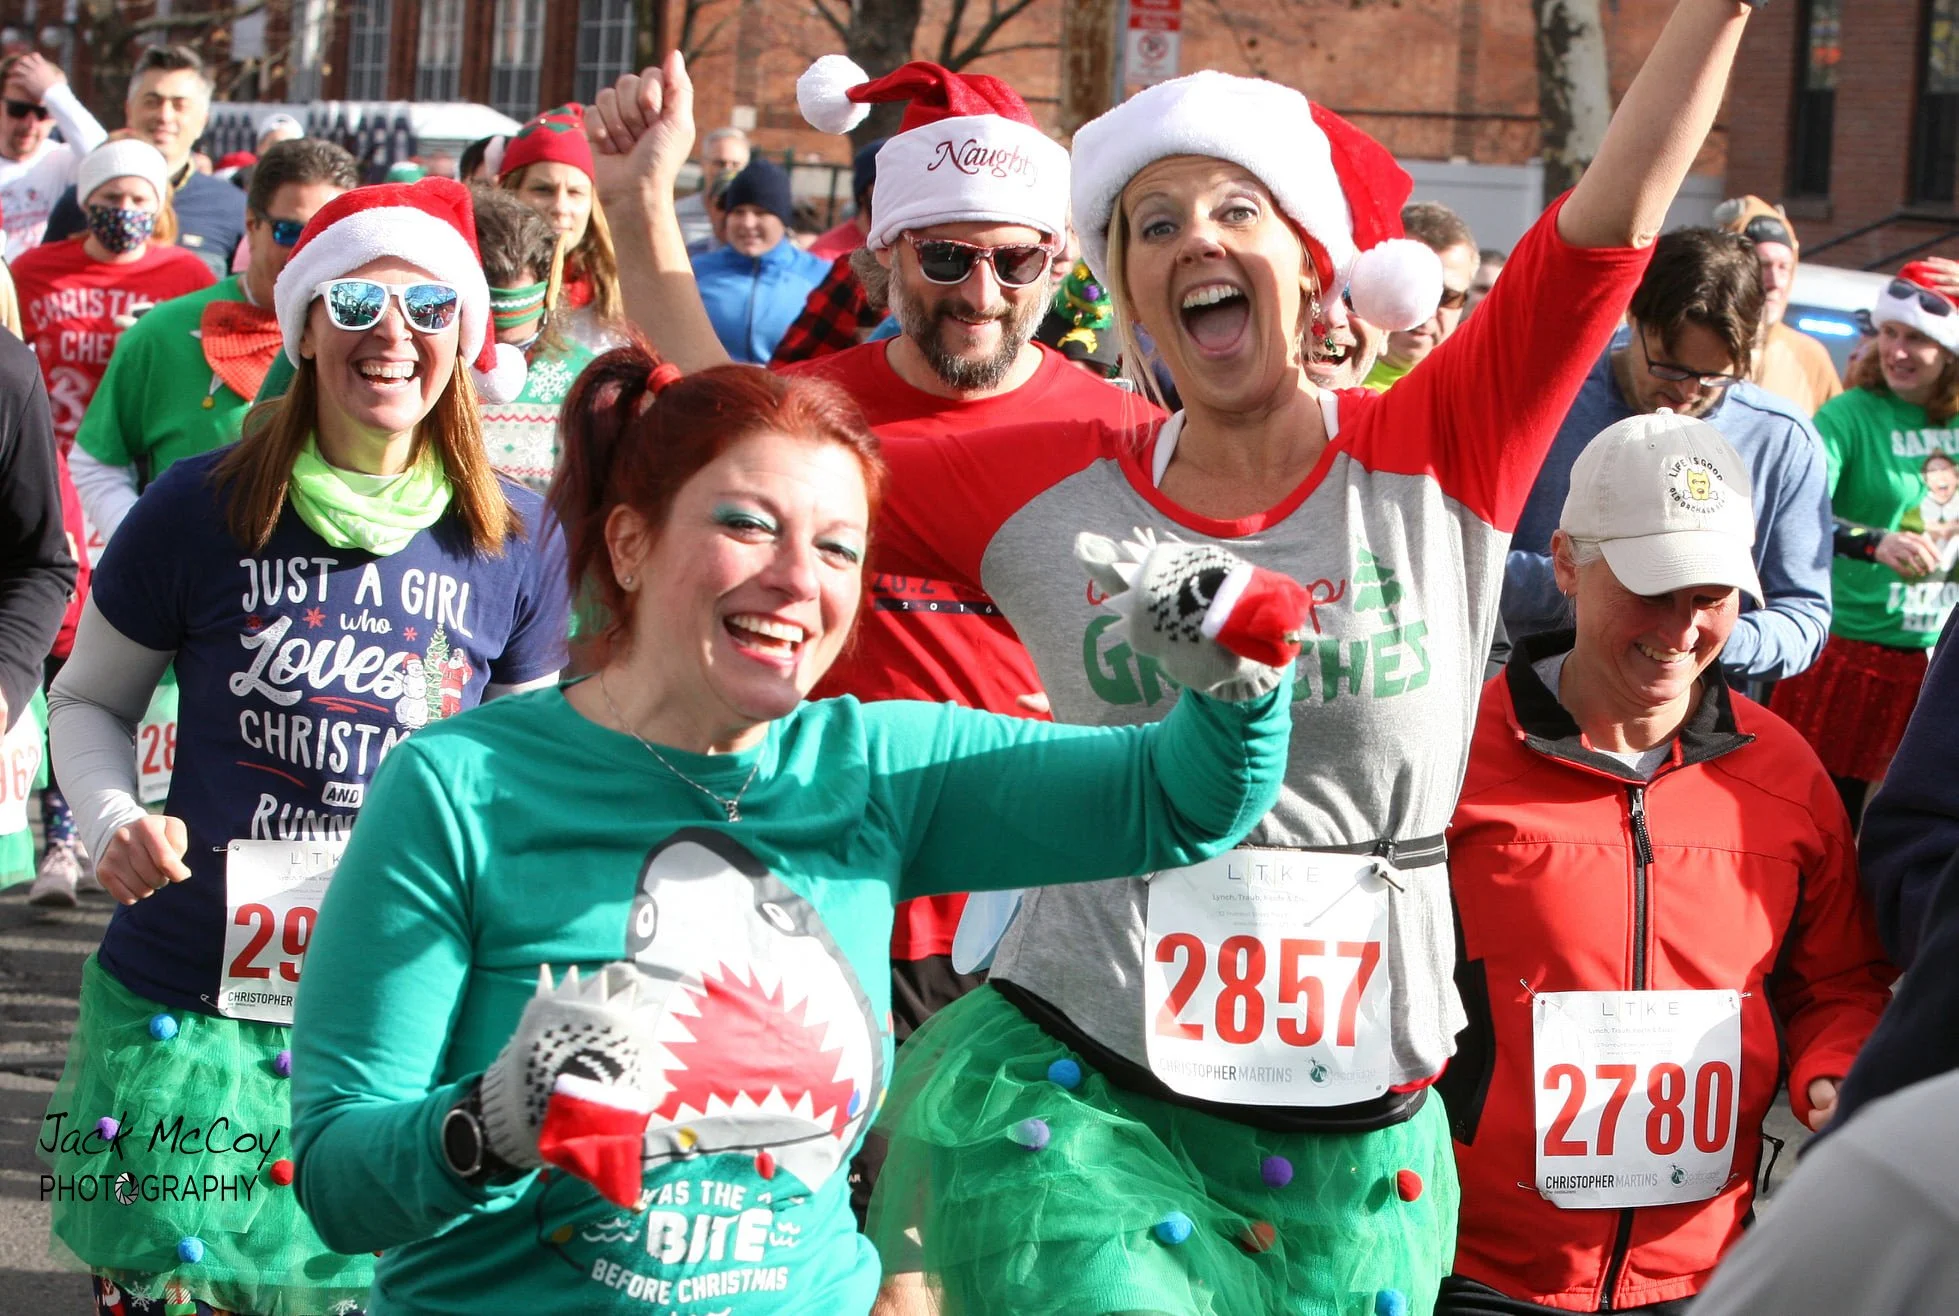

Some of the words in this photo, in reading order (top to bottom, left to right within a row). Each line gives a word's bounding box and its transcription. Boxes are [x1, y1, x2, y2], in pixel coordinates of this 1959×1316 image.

[1668, 458, 1688, 478] LIFE
[1688, 456, 1699, 466] IS
[1700, 458, 1724, 482] GOOD
[1669, 487, 1681, 502] OLD
[239, 556, 339, 613] JUST
[354, 562, 383, 607] A
[401, 568, 474, 640] GIRL
[339, 608, 393, 635] who
[228, 615, 411, 707] Loves
[326, 789, 360, 805] AND
[227, 990, 294, 1008] CHRISTOPHER
[1154, 932, 1381, 1047] 2857
[1158, 1057, 1237, 1081] CHRISTOPHER
[1238, 1065, 1293, 1083] MARTINS
[1543, 1060, 1734, 1157] 2780
[700, 1180, 747, 1211] THE
[1545, 1174, 1615, 1190] CHRISTOPHER
[1615, 1173, 1659, 1188] MARTINS
[645, 1207, 774, 1265] BITE
[591, 1258, 673, 1305] BEFORE
[677, 1266, 788, 1303] CHRISTMAS
